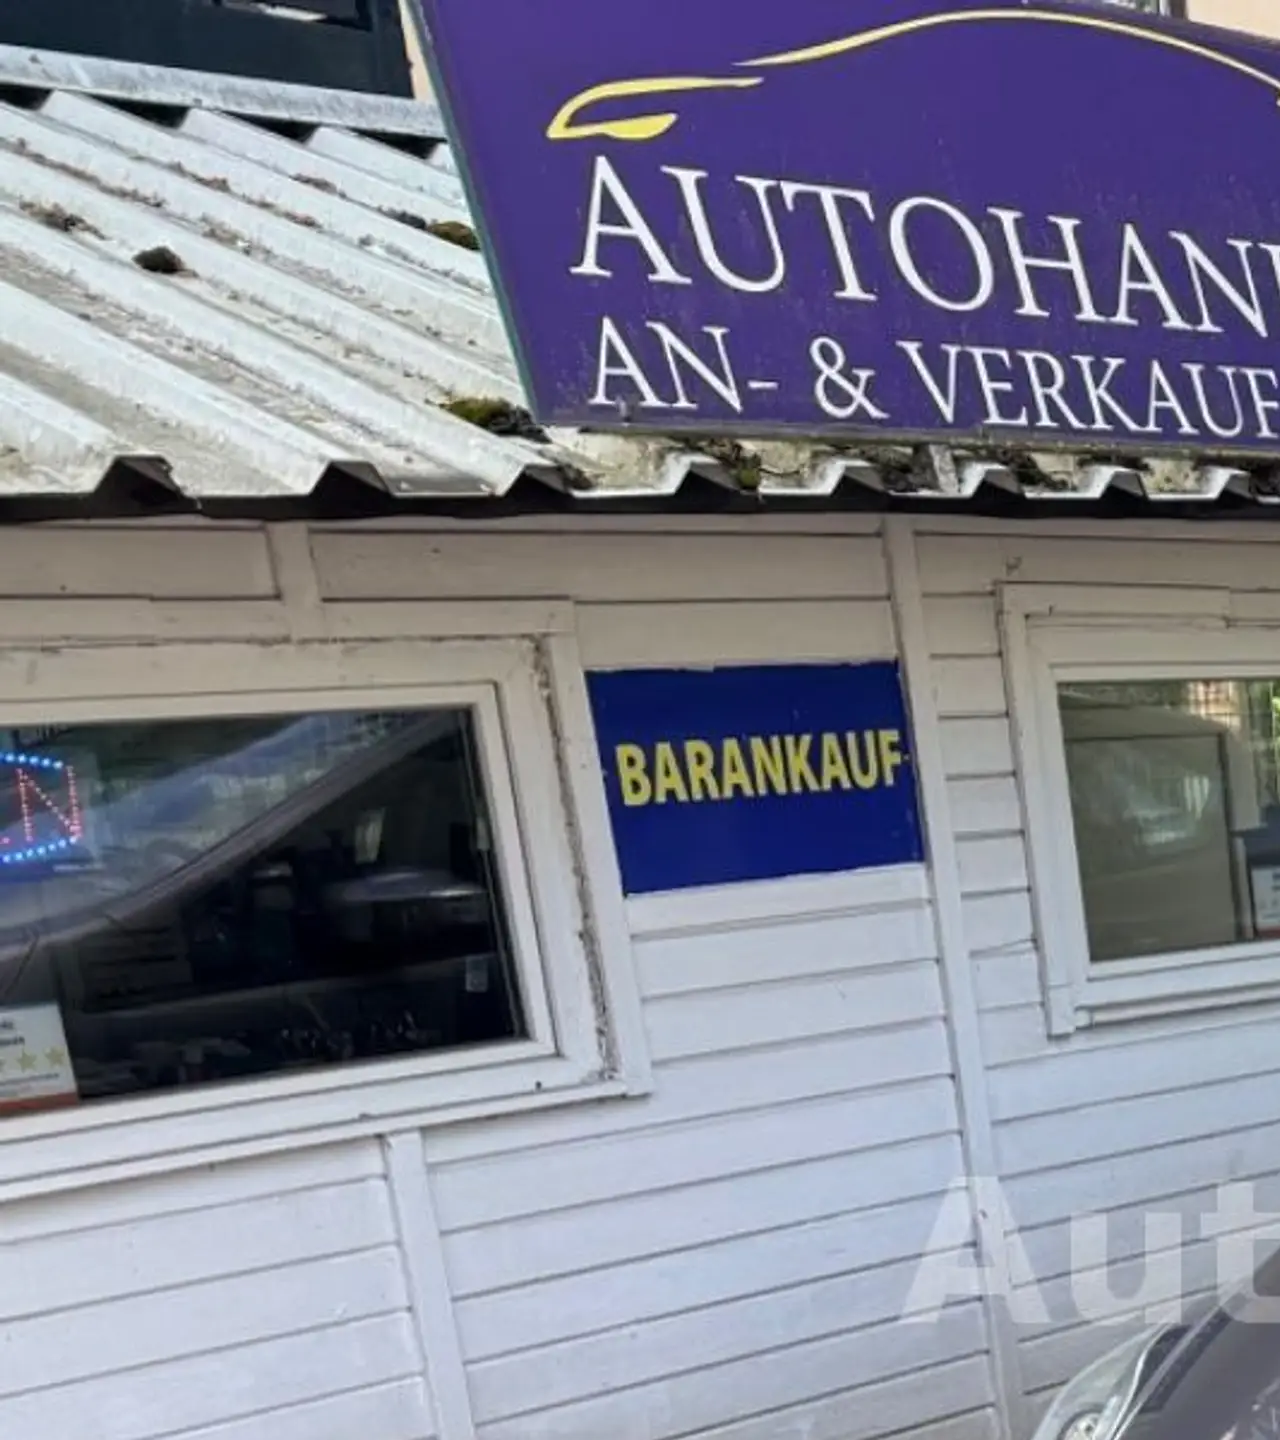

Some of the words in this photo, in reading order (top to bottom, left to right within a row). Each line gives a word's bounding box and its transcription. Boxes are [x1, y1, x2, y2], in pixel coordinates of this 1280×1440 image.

[588, 316, 779, 414] AN-
[809, 336, 889, 420] &
[897, 340, 1280, 440] VERKAUF
[615, 729, 905, 807] BARANKAUF
